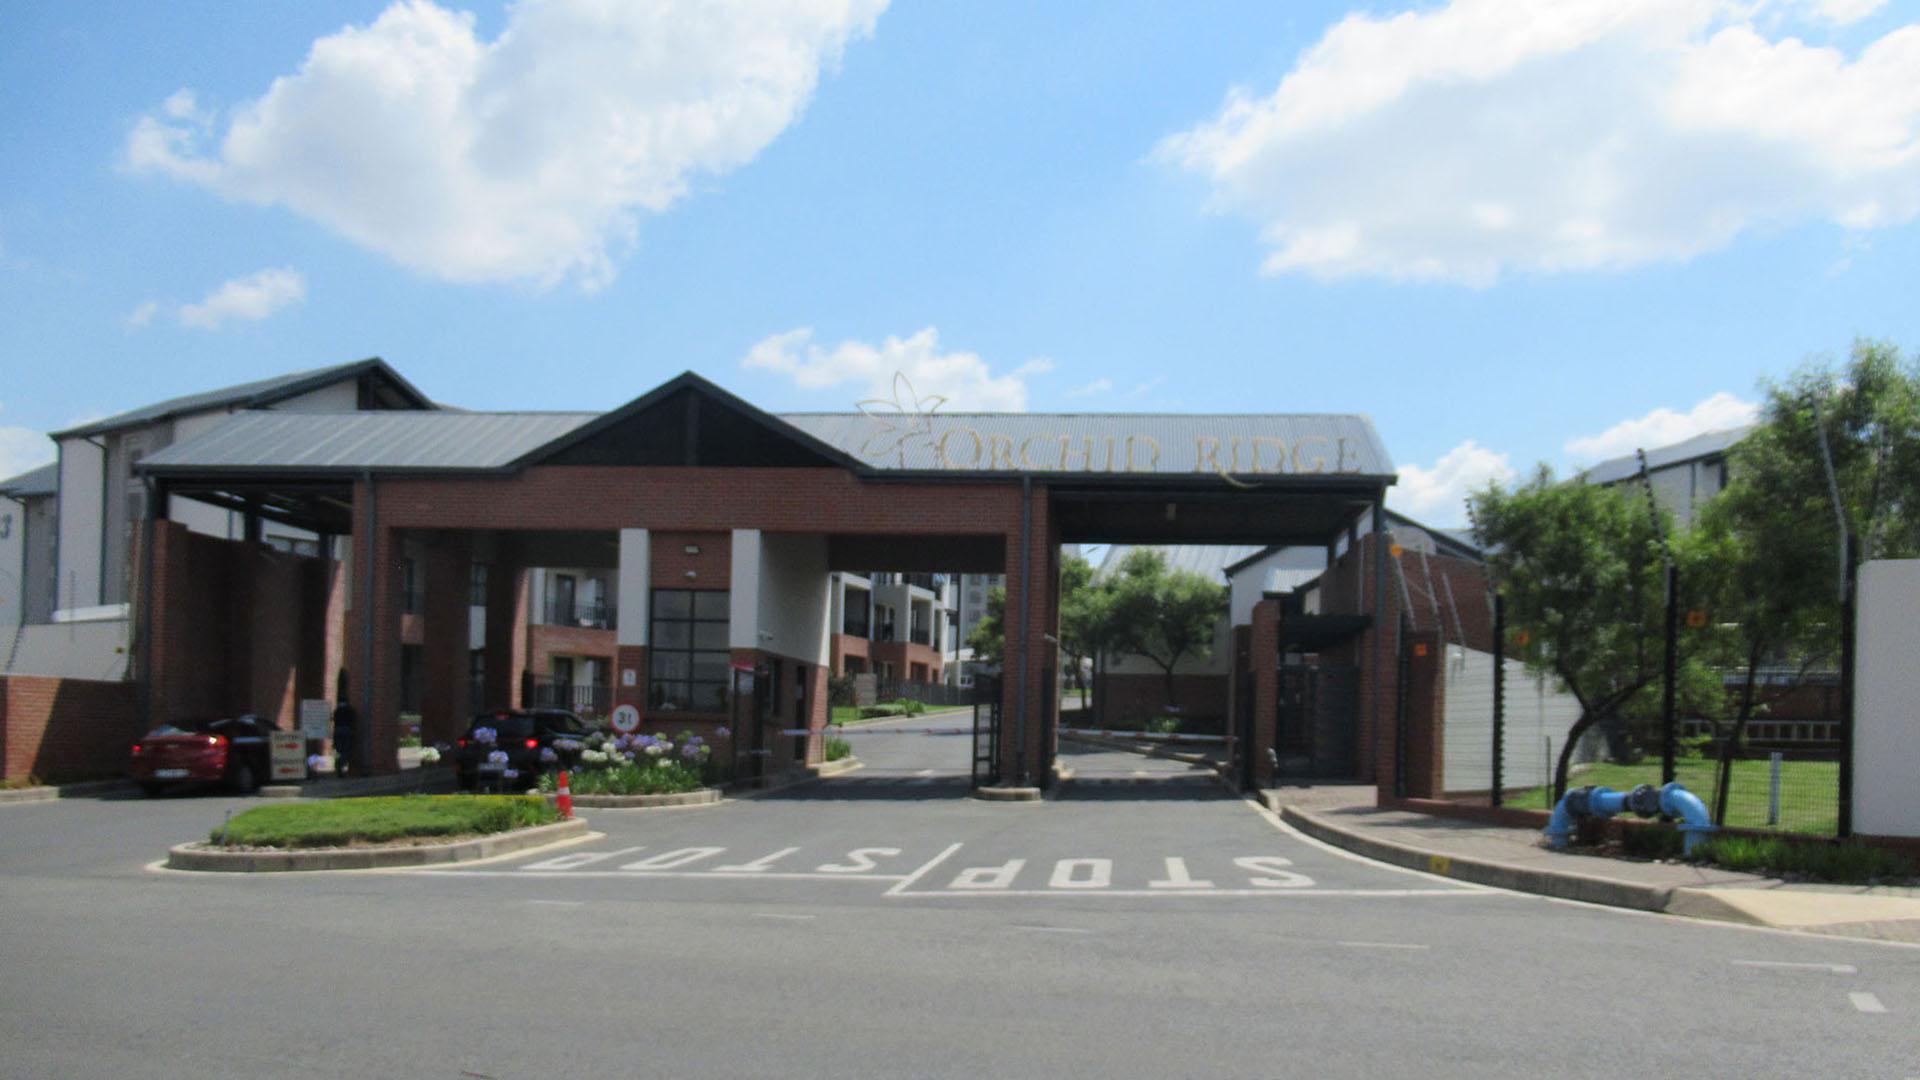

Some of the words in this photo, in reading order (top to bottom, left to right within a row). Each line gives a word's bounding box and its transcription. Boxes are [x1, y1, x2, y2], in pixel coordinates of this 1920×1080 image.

[939, 426, 1161, 472] ORCHID
[1195, 434, 1362, 488] RIDGE
[519, 846, 901, 872] STOP
[946, 856, 1316, 889] STOP
